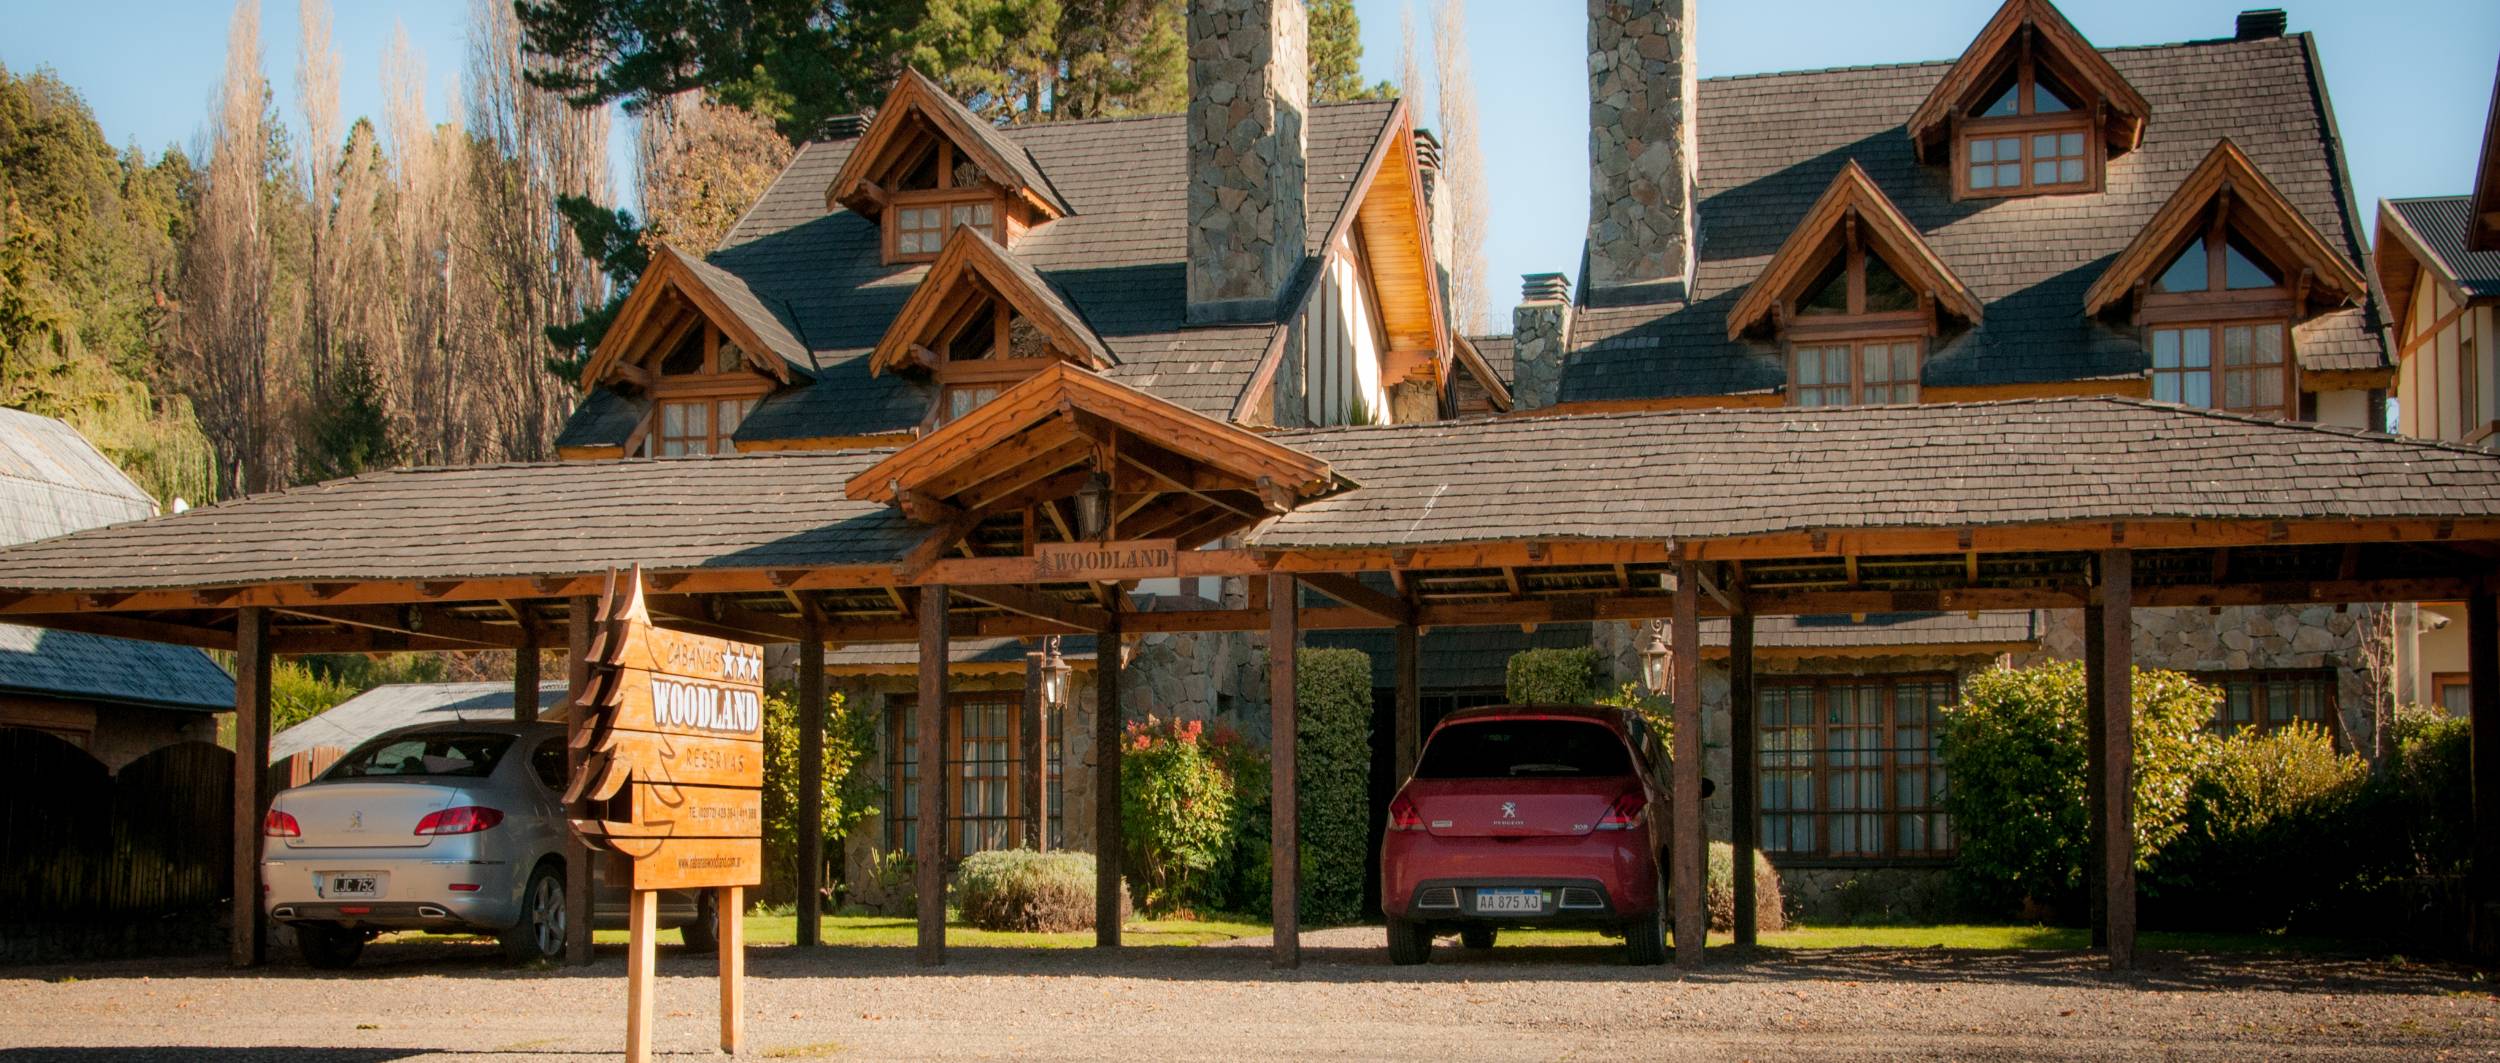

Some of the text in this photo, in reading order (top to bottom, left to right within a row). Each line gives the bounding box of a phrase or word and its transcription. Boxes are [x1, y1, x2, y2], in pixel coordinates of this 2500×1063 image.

[1054, 549, 1169, 571] WOODLAND
[1942, 595, 1951, 606] 2
[667, 641, 719, 673] CABAÑAS
[652, 679, 758, 733] WOODLAND
[687, 747, 744, 772] RESERVAS
[334, 879, 375, 892] LJC 752
[1480, 896, 1539, 909] AA 875 XJ
